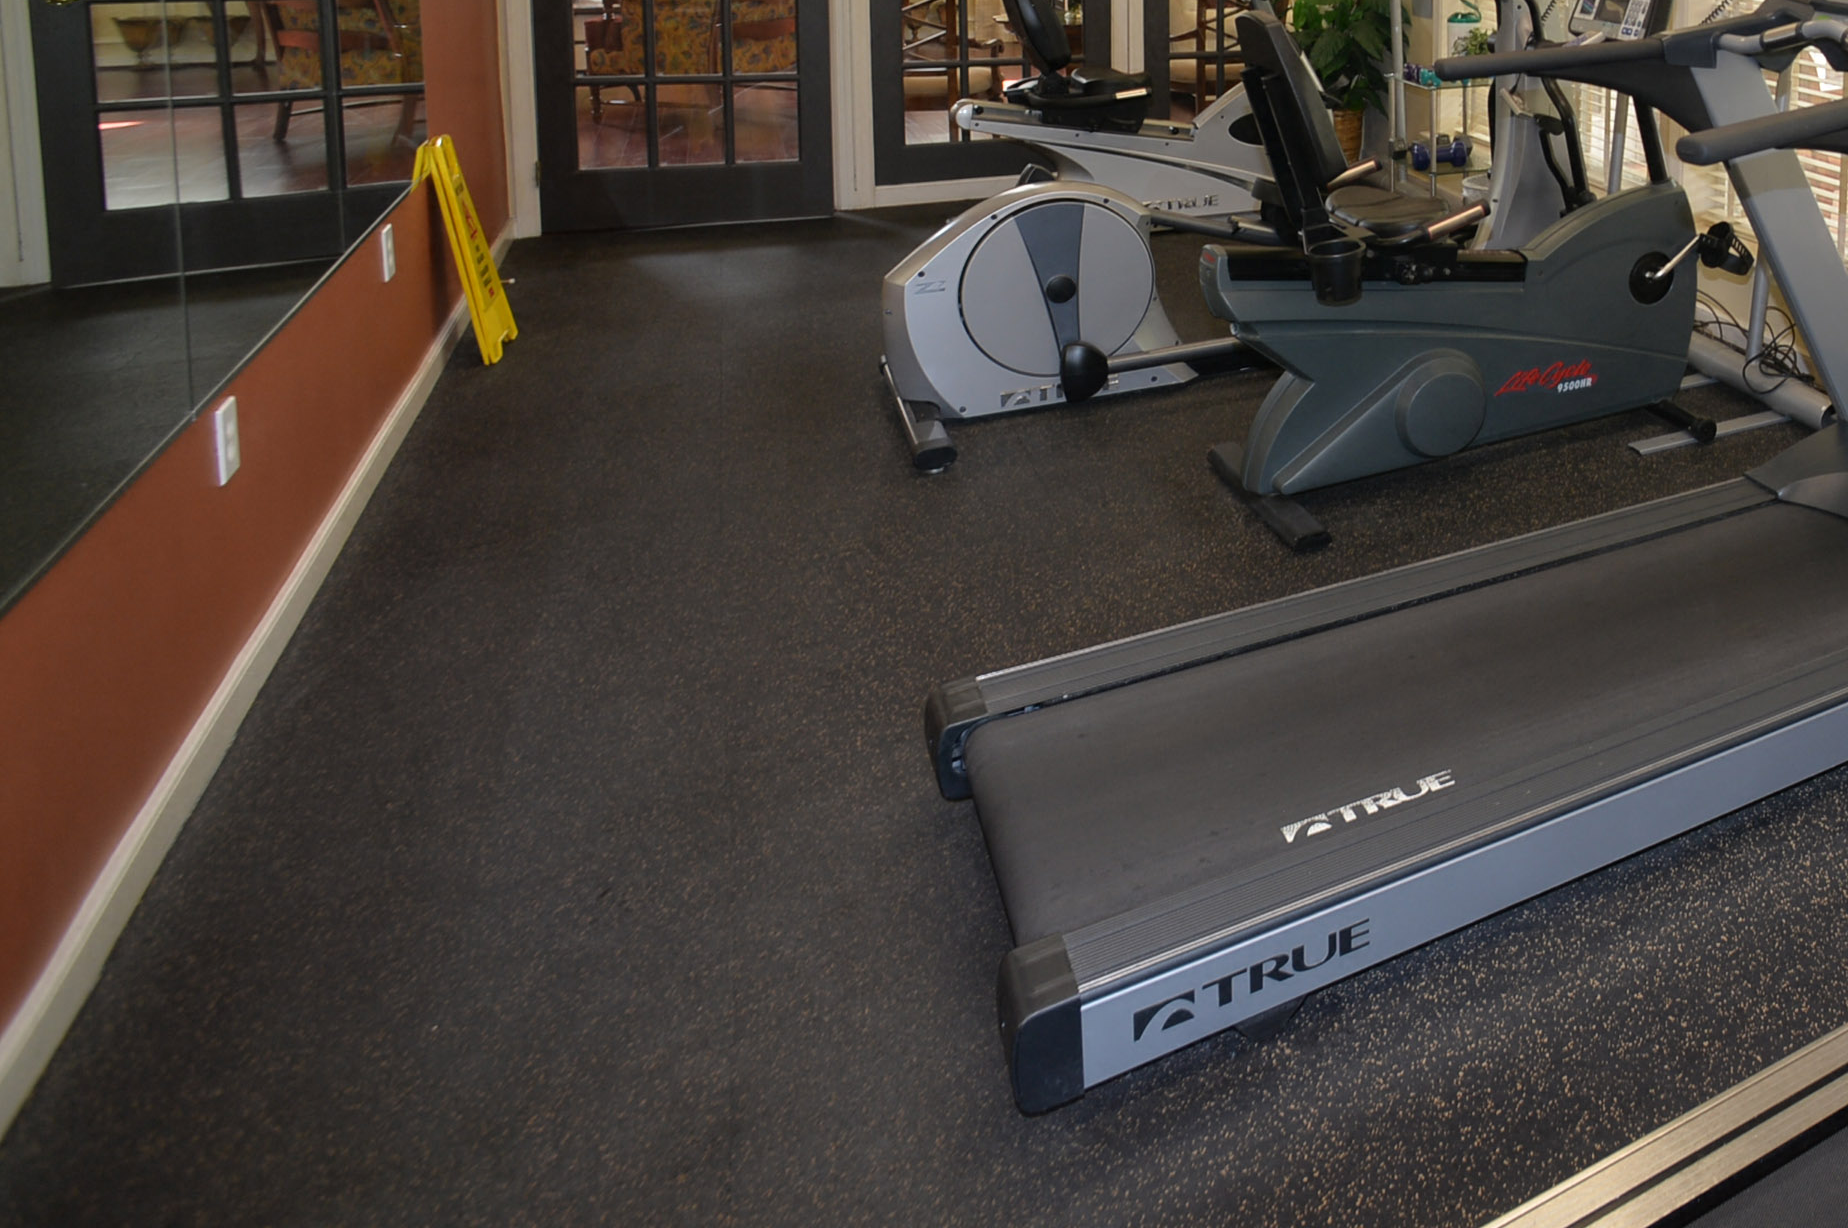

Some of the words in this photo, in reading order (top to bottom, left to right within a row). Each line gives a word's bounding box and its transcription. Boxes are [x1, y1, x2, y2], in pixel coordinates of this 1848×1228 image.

[1557, 377, 1593, 393] 9500HR
[1327, 769, 1456, 823] TRUE
[1202, 918, 1371, 1008] TRUE
